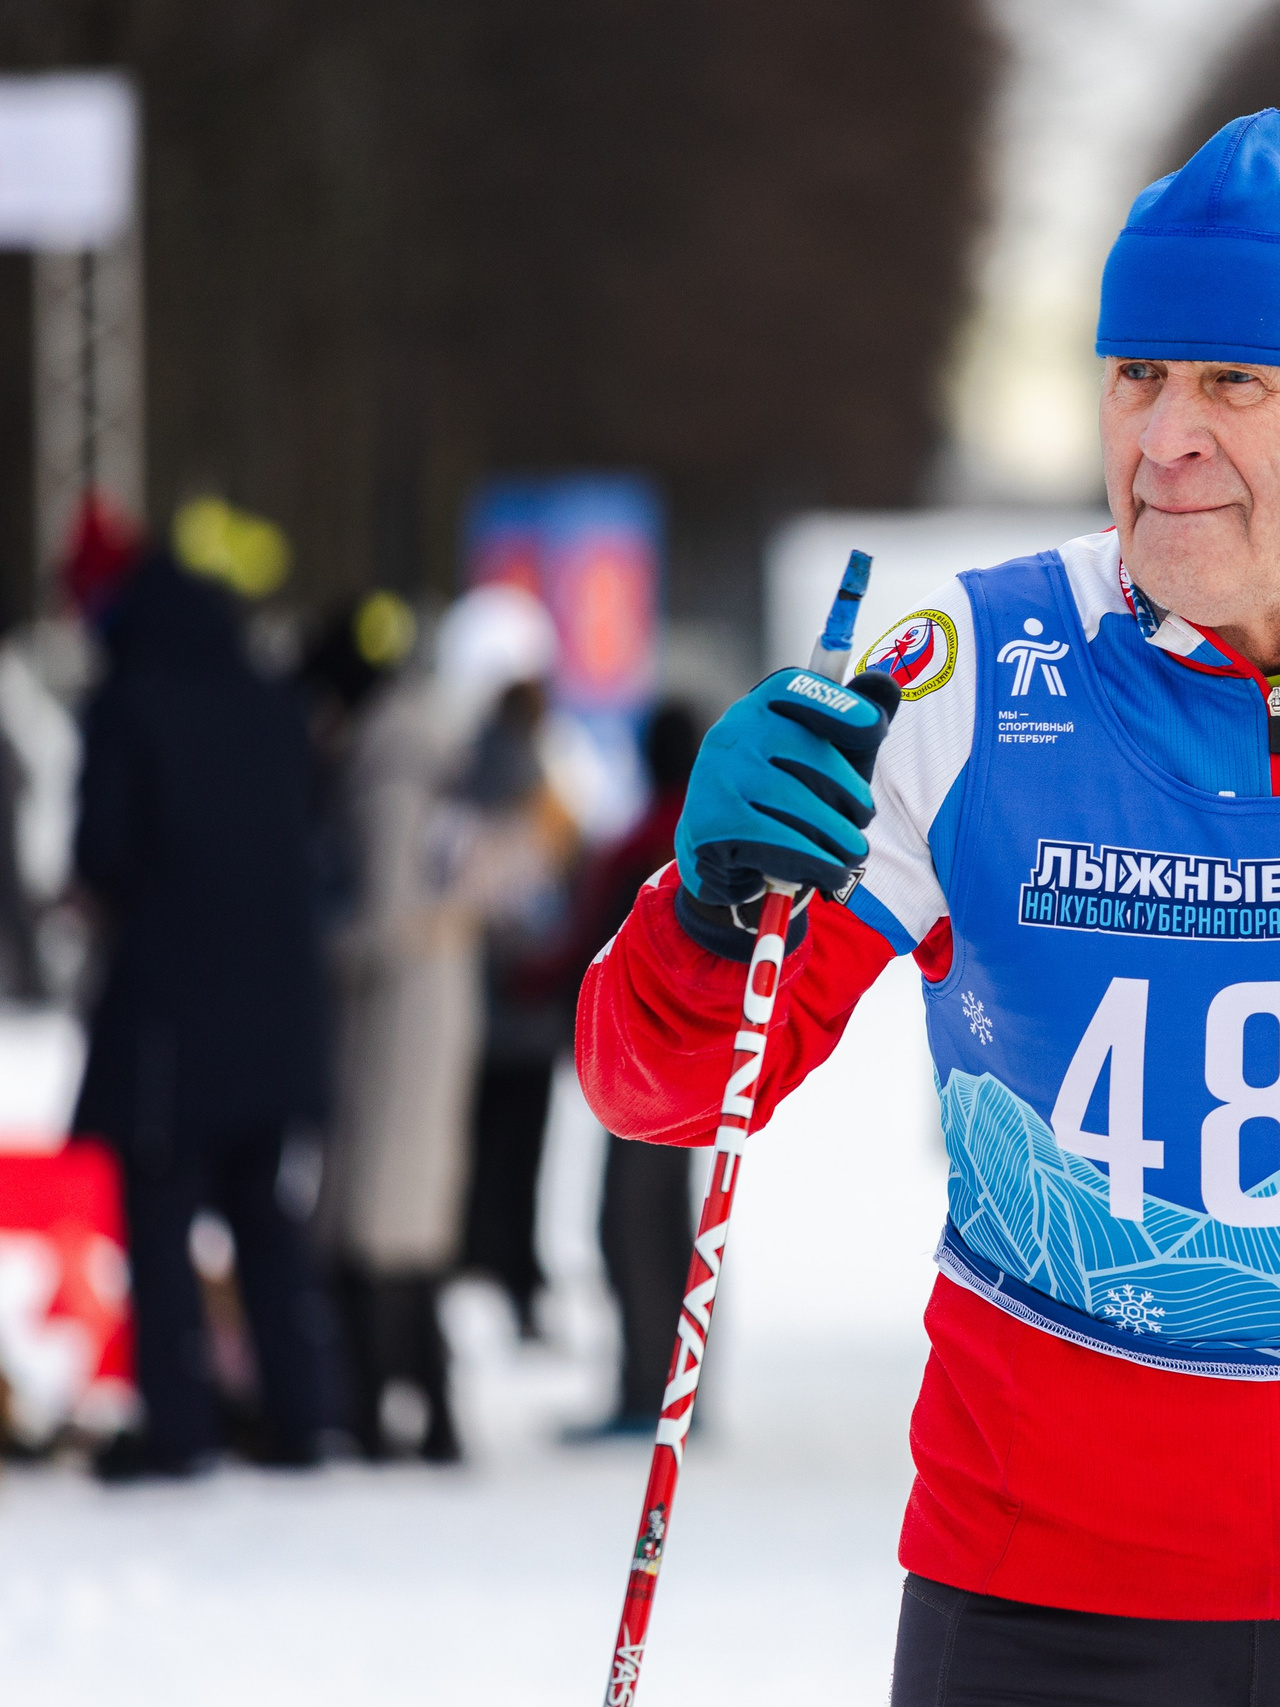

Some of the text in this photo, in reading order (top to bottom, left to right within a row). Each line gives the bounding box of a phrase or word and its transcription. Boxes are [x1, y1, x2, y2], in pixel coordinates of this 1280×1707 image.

[786, 673, 859, 713] RUSSIA
[998, 710, 1018, 720] МЫ
[998, 721, 1075, 733] СПОРТИВНЫЙ
[998, 734, 1059, 744] ПЕТЕРБУРГ
[1024, 890, 1053, 921] НА
[1059, 893, 1128, 929] КУБОК
[655, 933, 785, 1469] ONE WAY
